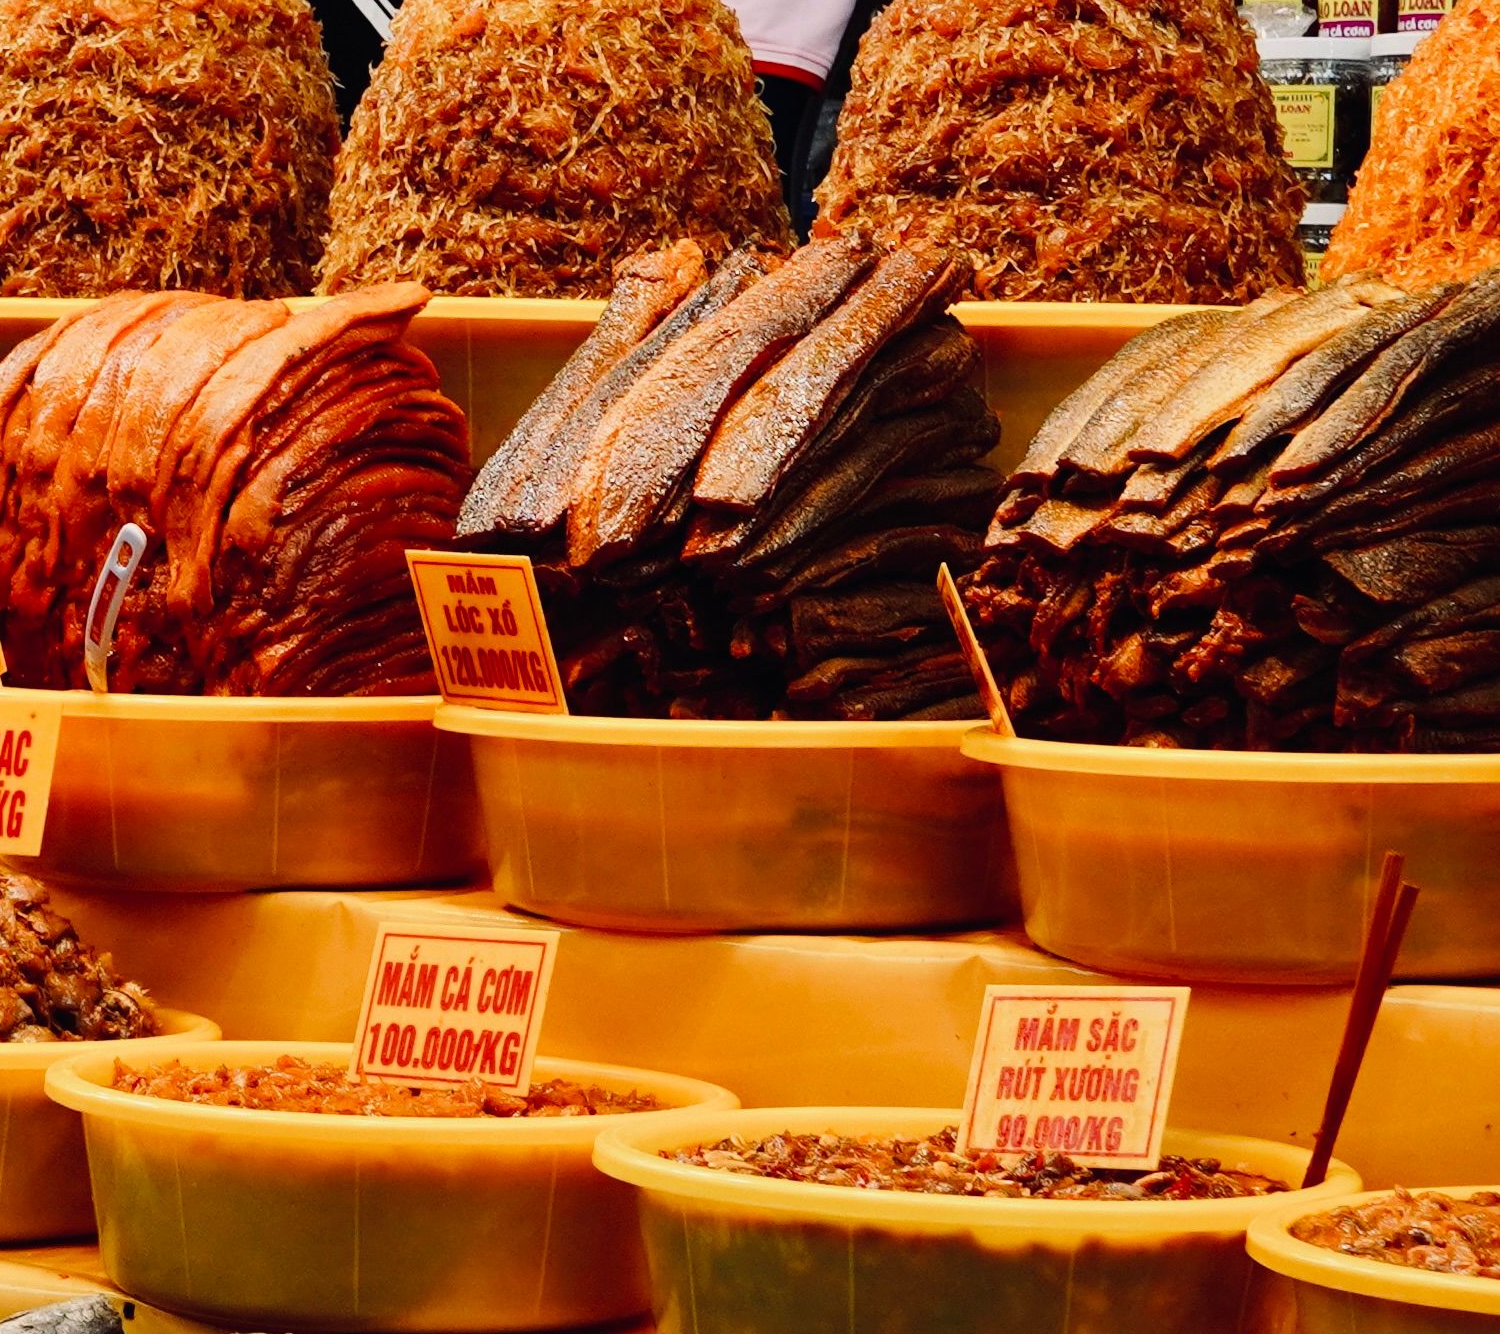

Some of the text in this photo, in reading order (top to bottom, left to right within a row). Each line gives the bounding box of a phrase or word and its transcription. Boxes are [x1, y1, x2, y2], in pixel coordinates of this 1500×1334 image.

[442, 601, 483, 634] LÓC
[440, 644, 549, 695] 120.000/KG
[377, 950, 535, 1017] MẮM CÁ CƠM
[366, 1021, 523, 1077] 100.000/KG
[1013, 1002, 1082, 1053] MẮM
[1050, 1066, 1140, 1106] XƯƠNG
[993, 1112, 1125, 1154] 90.000/KG
